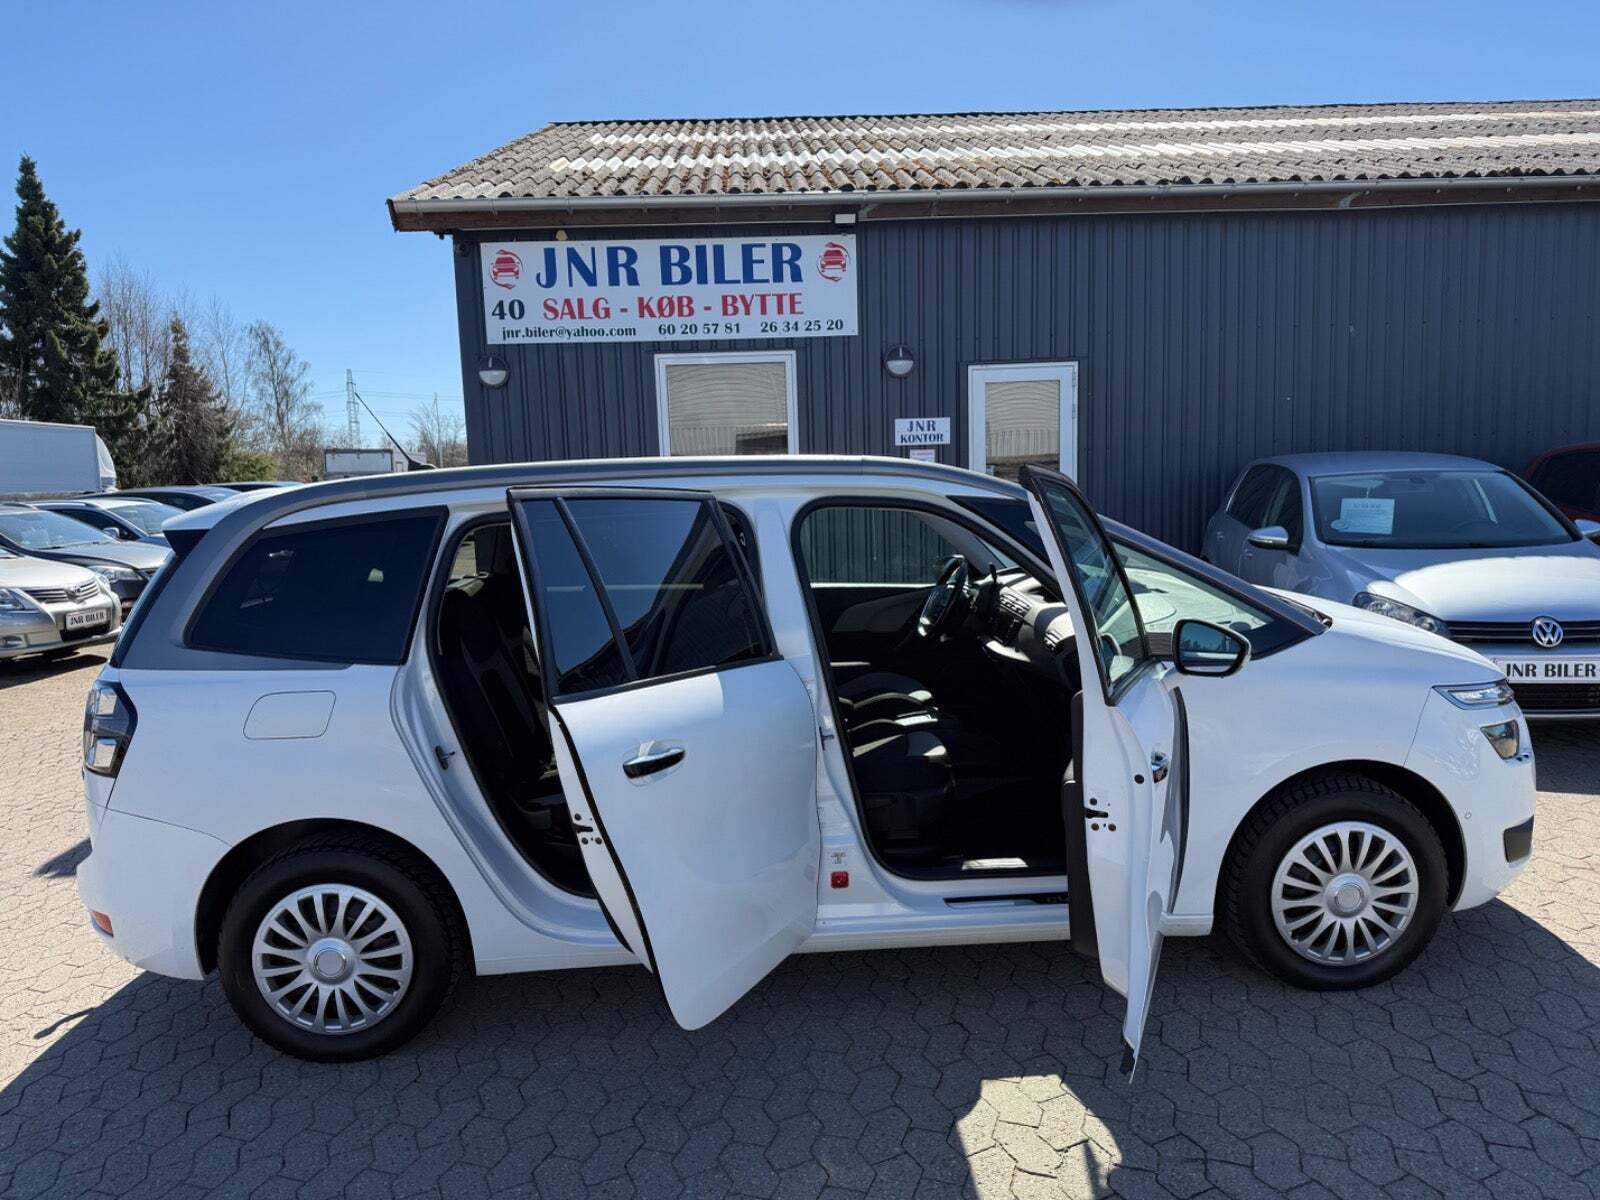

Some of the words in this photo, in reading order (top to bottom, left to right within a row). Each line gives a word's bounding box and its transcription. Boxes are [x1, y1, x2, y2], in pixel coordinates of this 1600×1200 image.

[536, 246, 640, 289] JNR
[660, 242, 804, 286] BILER
[491, 299, 525, 320] 40
[543, 297, 611, 321] SALG
[637, 294, 695, 319] KØB
[721, 292, 804, 317] BYTTE
[502, 325, 637, 341] jnr.biler@yahoo.com
[658, 323, 676, 336] 60
[680, 323, 698, 335] 20
[703, 322, 719, 334] 57
[724, 322, 740, 334] 81
[760, 321, 778, 333] 26
[782, 320, 799, 332] 34
[804, 320, 821, 332] 25
[826, 319, 844, 331] 20
[907, 420, 936, 432] JNR
[900, 433, 944, 444] KONTOR
[70, 615, 84, 626] JNR
[1544, 663, 1596, 678] BILER
